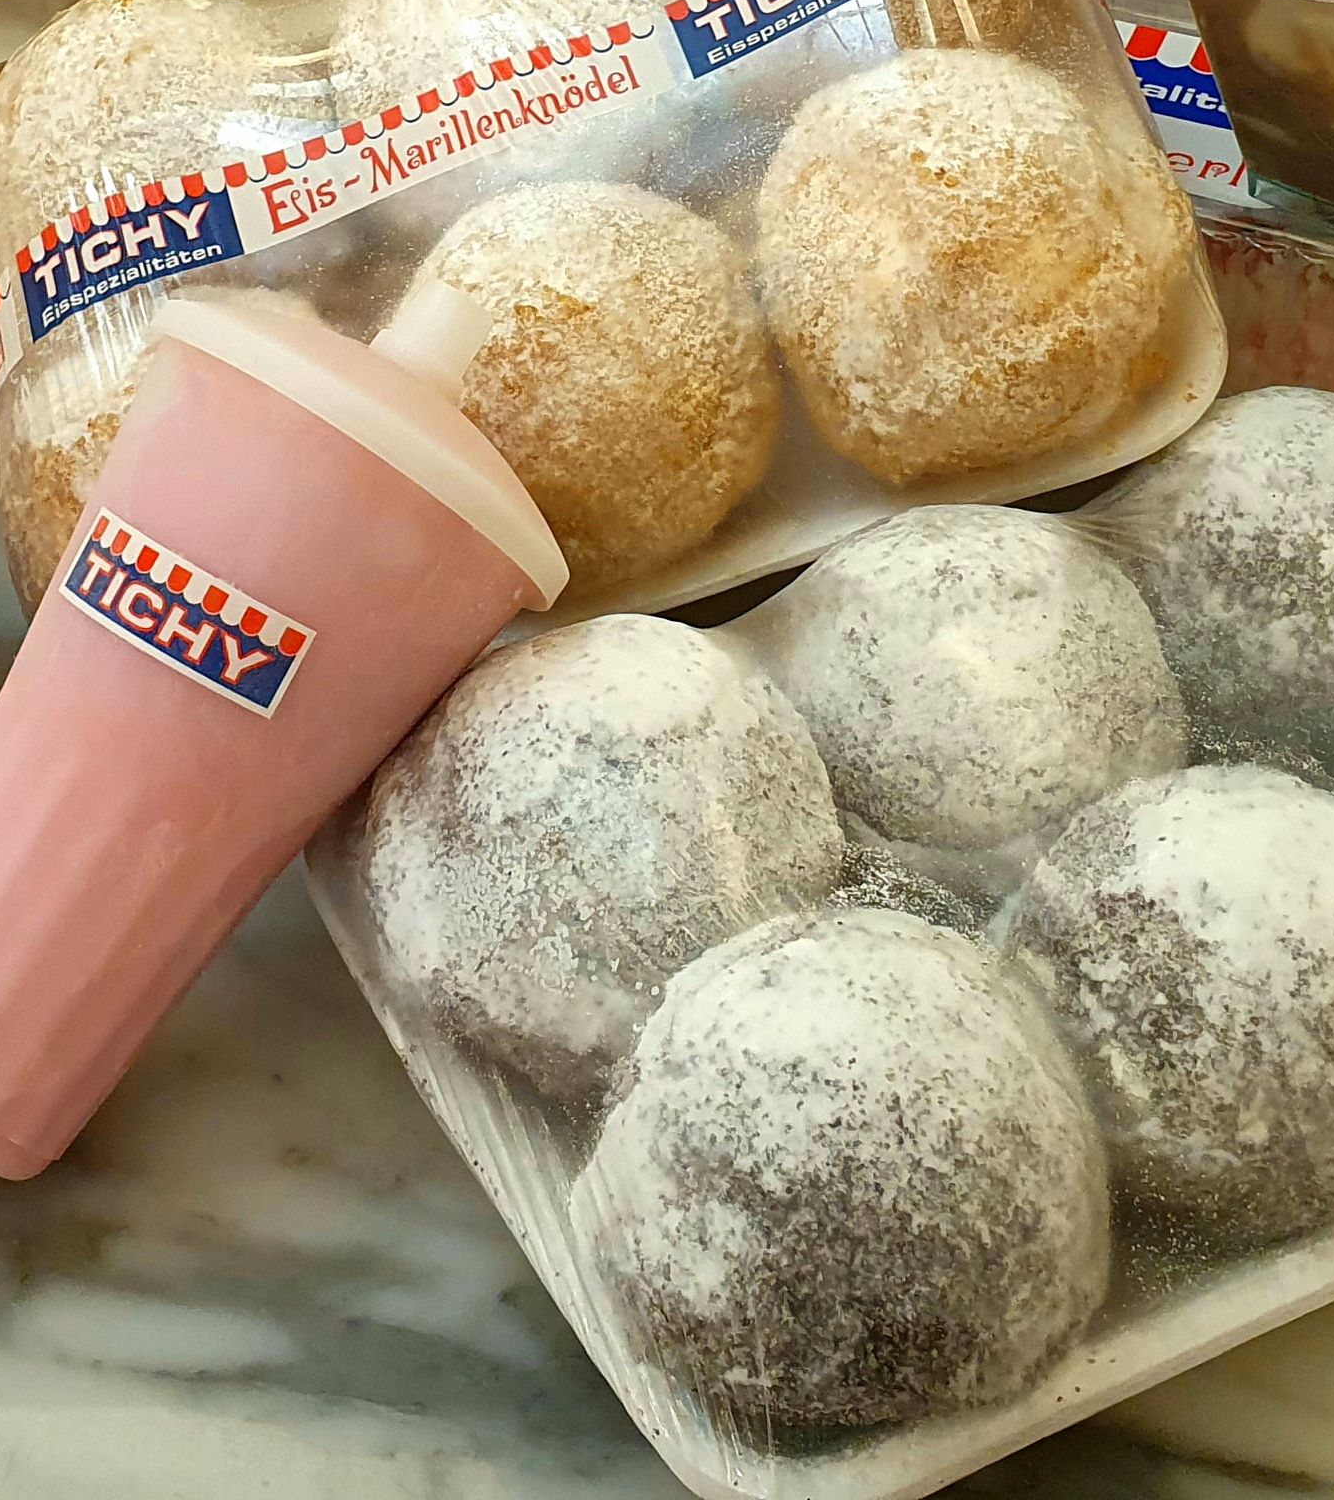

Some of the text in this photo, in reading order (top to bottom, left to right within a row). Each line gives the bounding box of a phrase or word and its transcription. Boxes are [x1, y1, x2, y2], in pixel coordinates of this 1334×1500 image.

[34, 200, 211, 299] TICHY
[41, 244, 223, 328] Eisspezialitäten
[81, 549, 276, 685] TICHY
